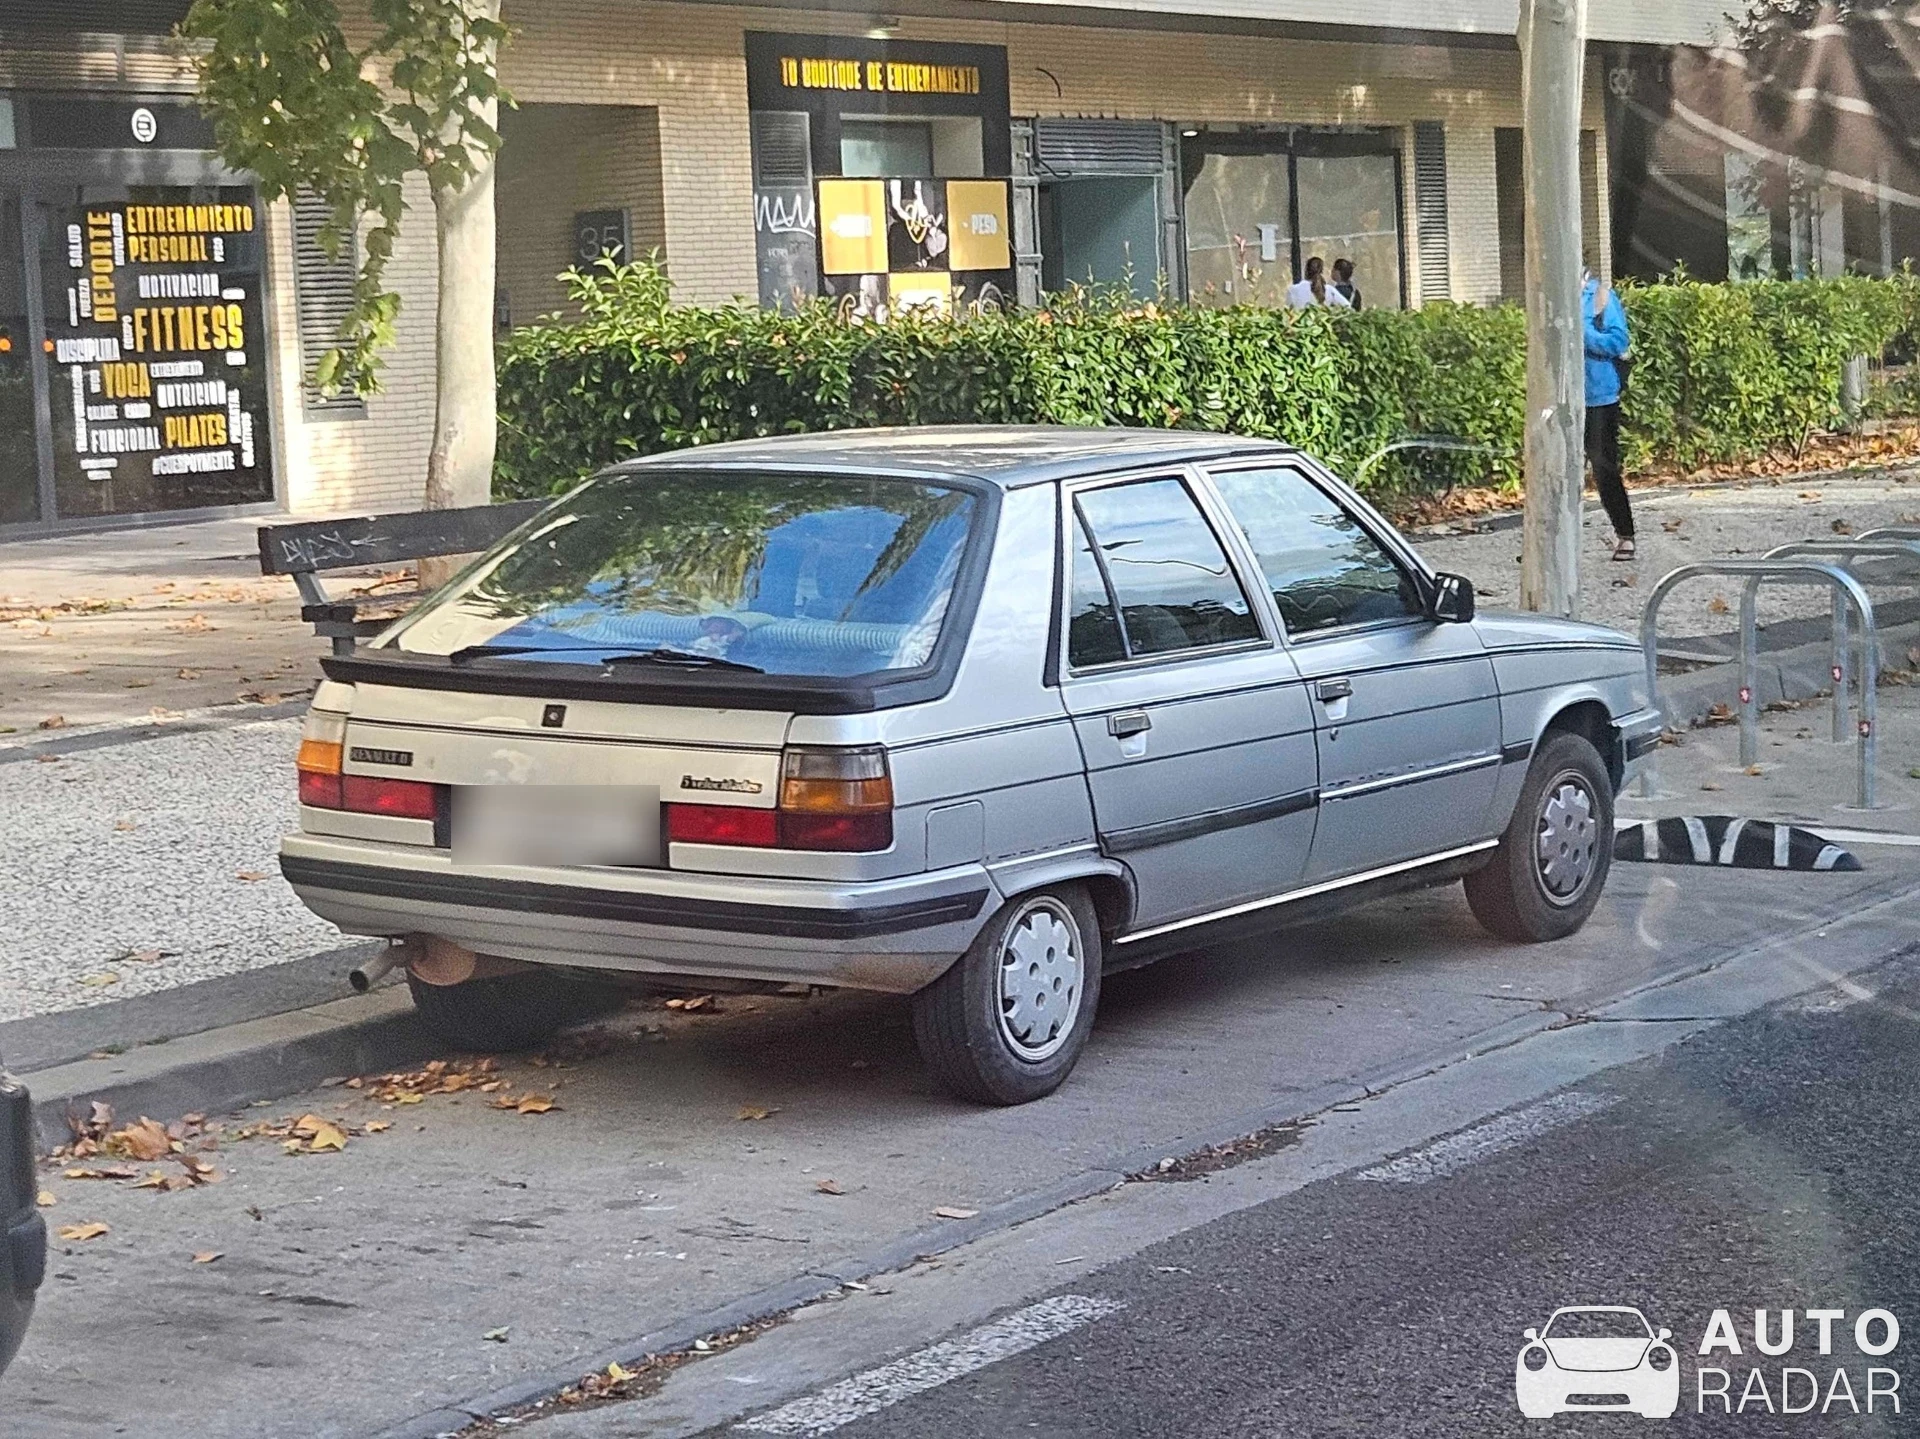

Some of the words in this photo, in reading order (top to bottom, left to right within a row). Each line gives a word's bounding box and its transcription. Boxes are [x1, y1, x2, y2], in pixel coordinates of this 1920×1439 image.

[802, 58, 862, 91] BOUTIQUE
[867, 61, 884, 91] DE
[887, 62, 979, 94] ENTRENAMIENTO
[126, 205, 253, 233] ENTRENAMIENTO
[67, 224, 83, 268] SALUD
[128, 235, 208, 262] PERSONAL
[580, 226, 621, 261] 35
[88, 211, 117, 322] DEPORTE
[78, 278, 92, 318] FUERZA
[133, 304, 244, 352] FITNESS
[56, 337, 121, 363] DISCIPLINA
[102, 362, 151, 398] YOGA
[91, 426, 161, 453] FUNCIONAL
[165, 413, 227, 449] PILATES
